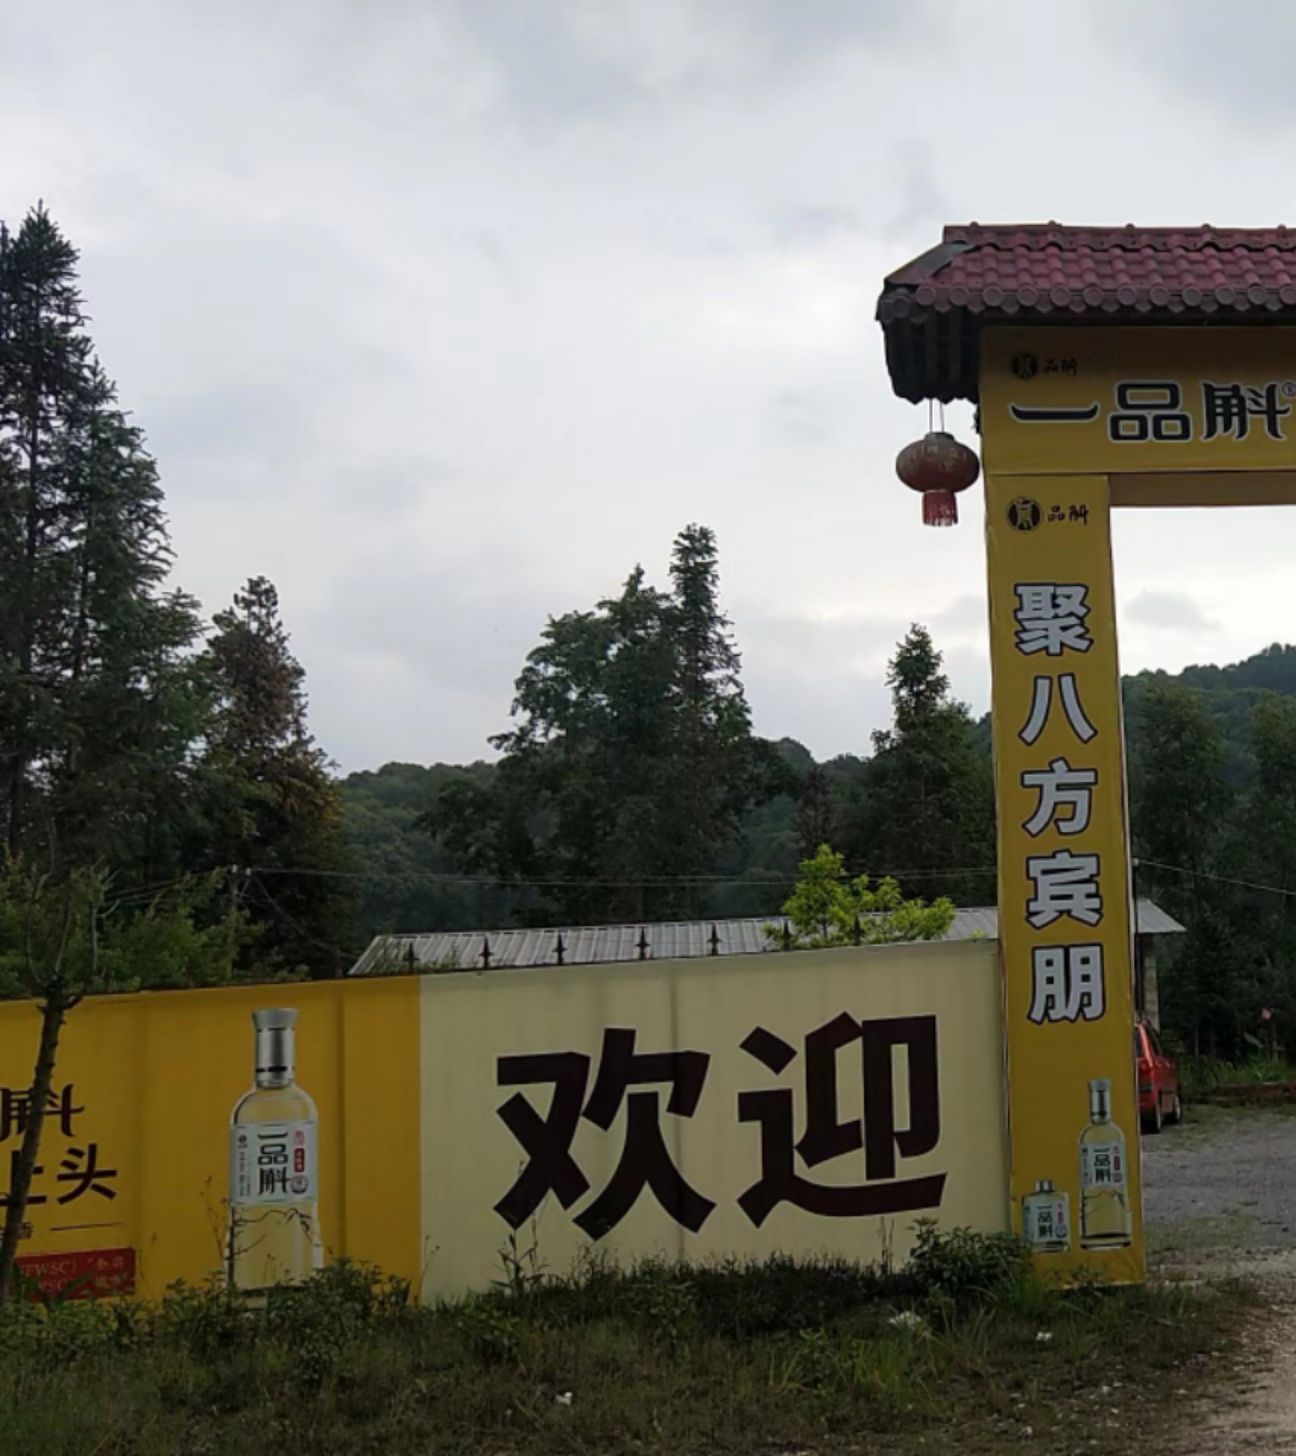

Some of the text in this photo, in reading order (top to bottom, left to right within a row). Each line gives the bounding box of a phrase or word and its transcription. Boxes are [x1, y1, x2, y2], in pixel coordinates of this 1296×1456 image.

[1014, 583, 1106, 1025] 聚八方宾朋
[494, 1011, 947, 1241] 欢迎
